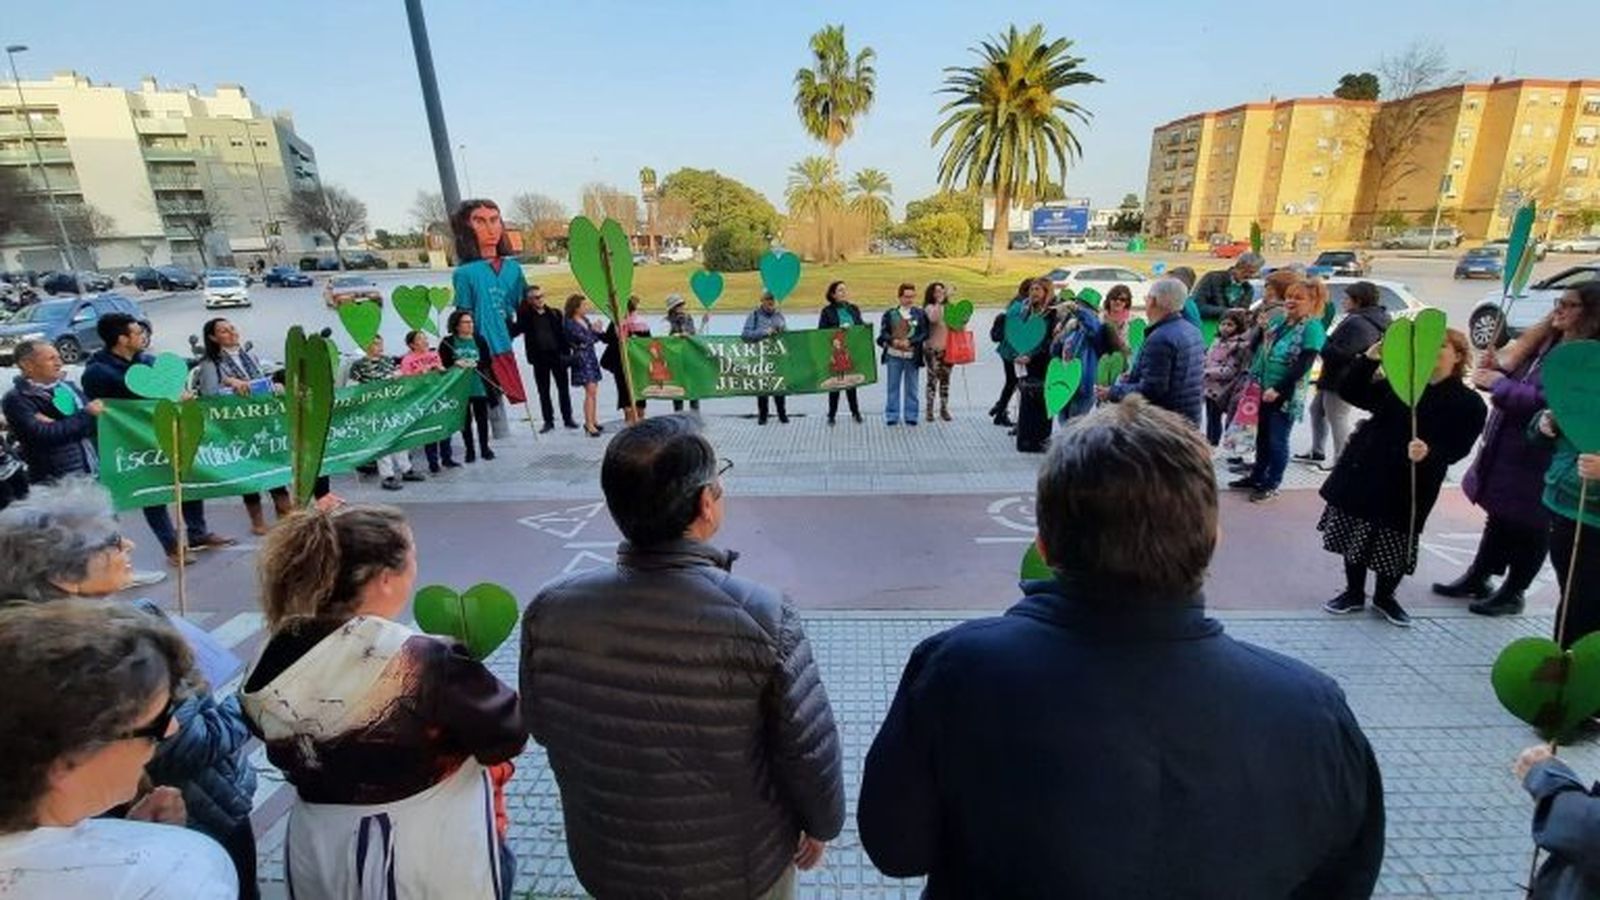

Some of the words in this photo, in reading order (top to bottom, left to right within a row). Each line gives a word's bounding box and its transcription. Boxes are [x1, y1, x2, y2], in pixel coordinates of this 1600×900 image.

[707, 339, 786, 357] MAREA
[715, 376, 785, 391] JEREZ
[209, 401, 287, 420] MAREA
